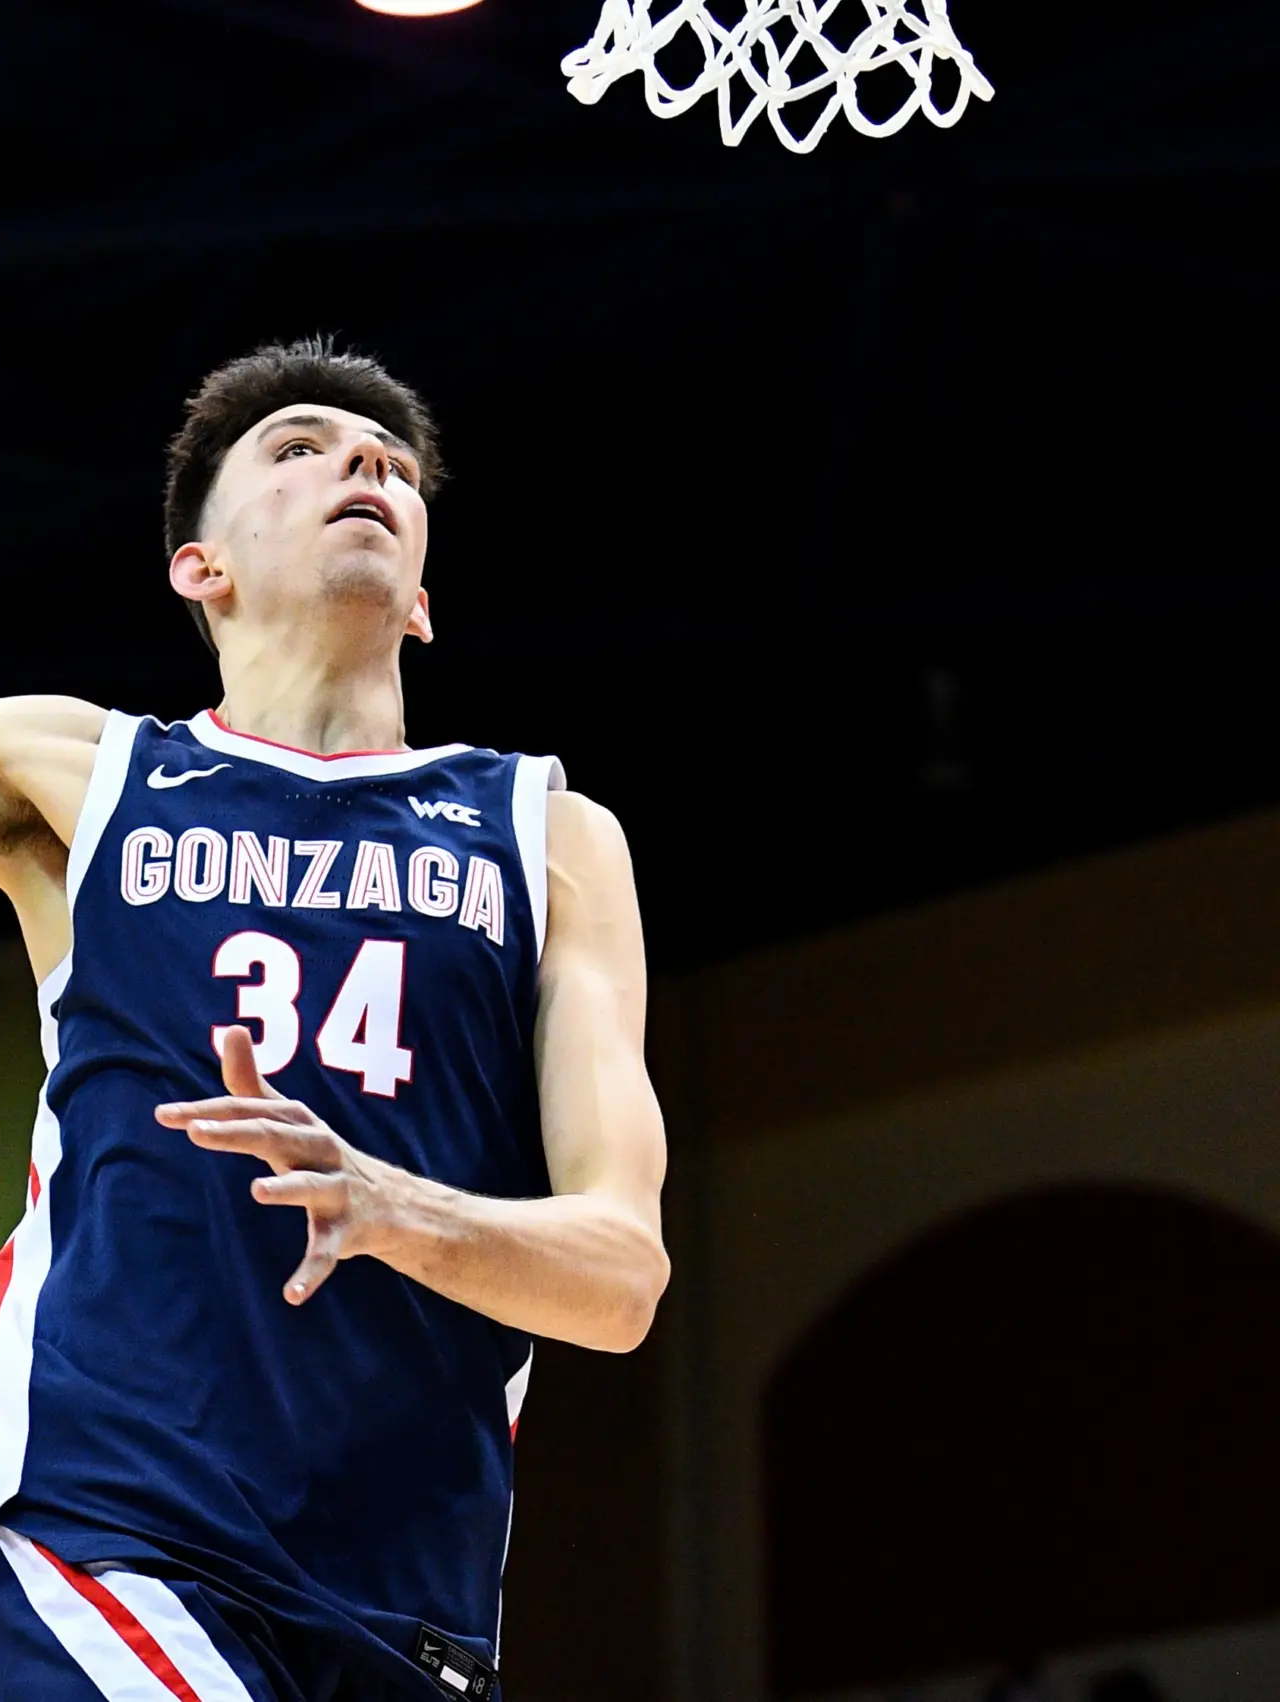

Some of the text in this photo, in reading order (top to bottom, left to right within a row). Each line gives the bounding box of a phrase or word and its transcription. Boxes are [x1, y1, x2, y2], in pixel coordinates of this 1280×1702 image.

[407, 796, 482, 828] WCC
[120, 826, 505, 947] GONZAGA
[211, 930, 412, 1099] 34
